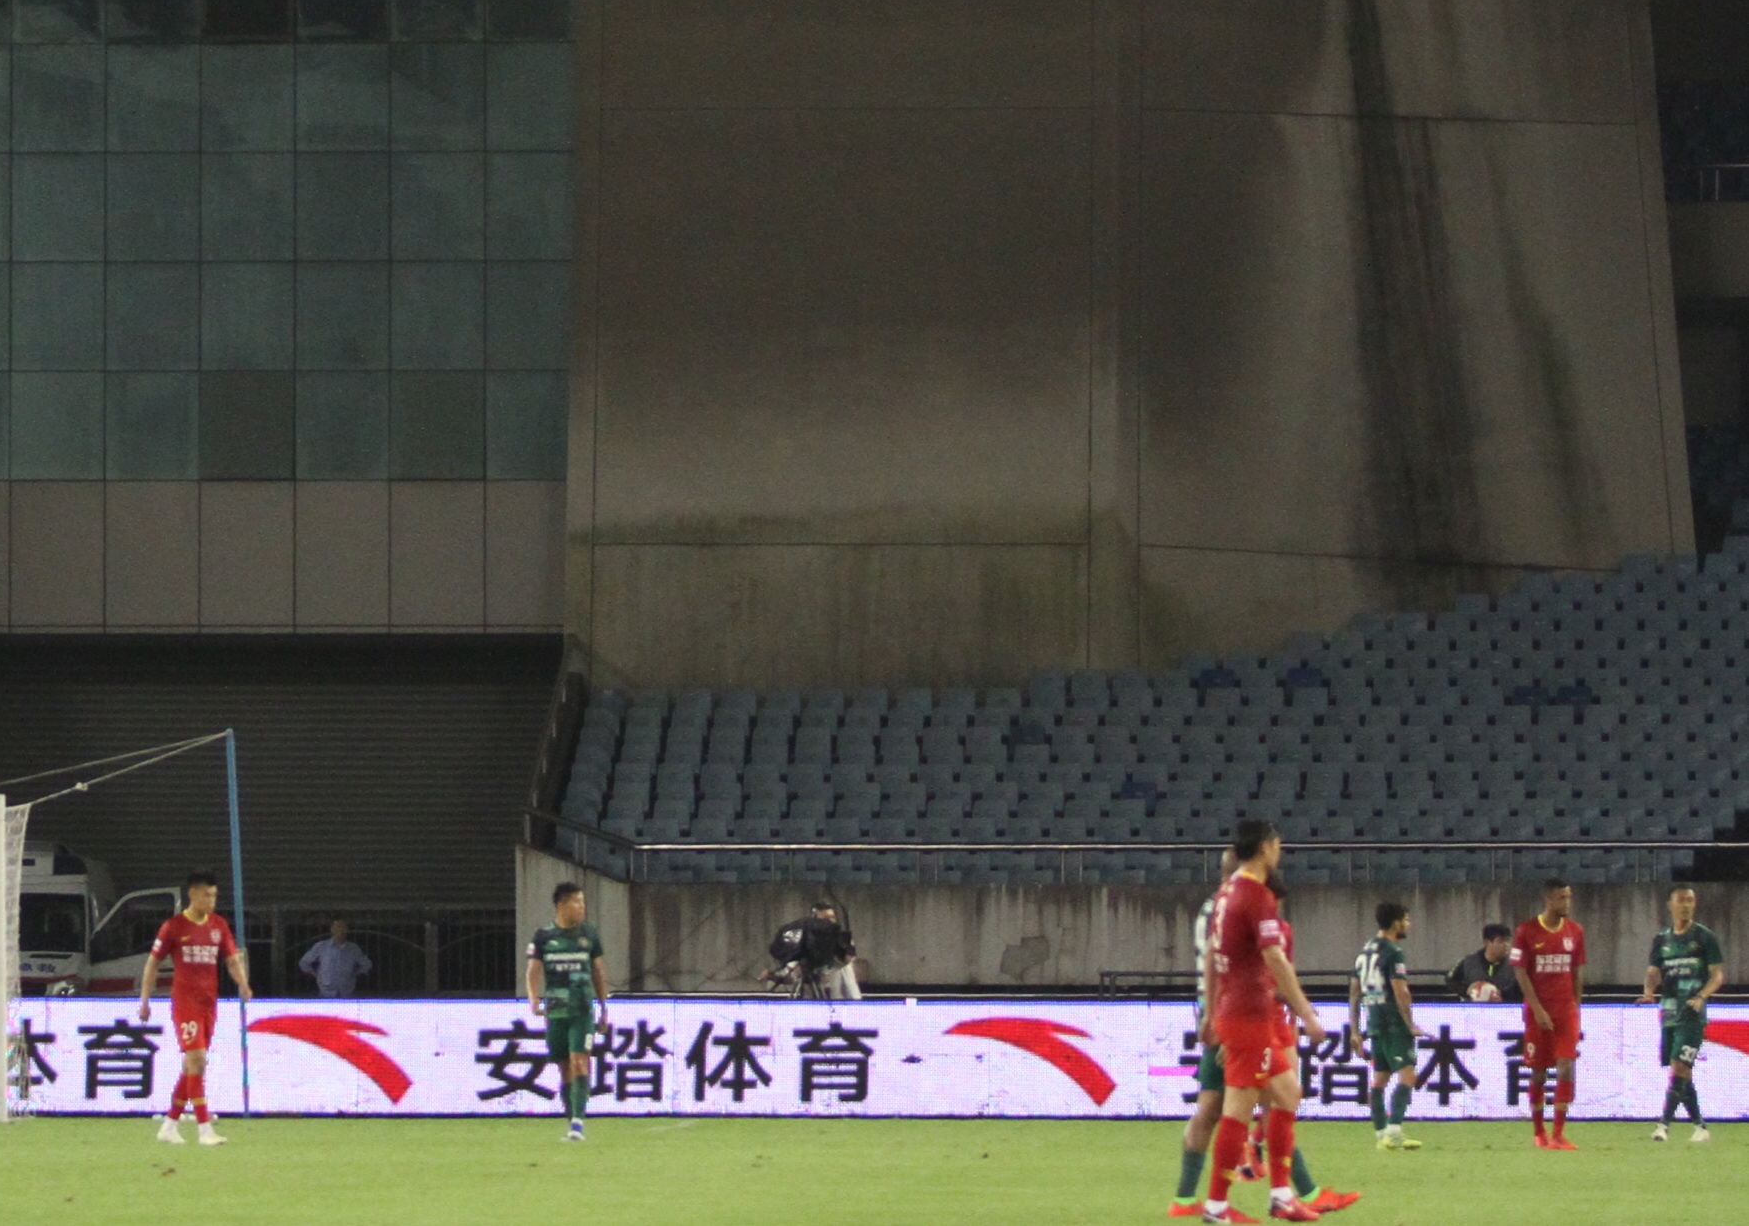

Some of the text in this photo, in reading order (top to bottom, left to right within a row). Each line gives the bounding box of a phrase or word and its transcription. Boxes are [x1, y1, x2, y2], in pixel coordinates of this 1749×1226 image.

[180, 1020, 198, 1040] 29
[474, 1019, 878, 1103] 安踏体育
[1261, 1047, 1271, 1071] 3
[1526, 1042, 1536, 1059] 9
